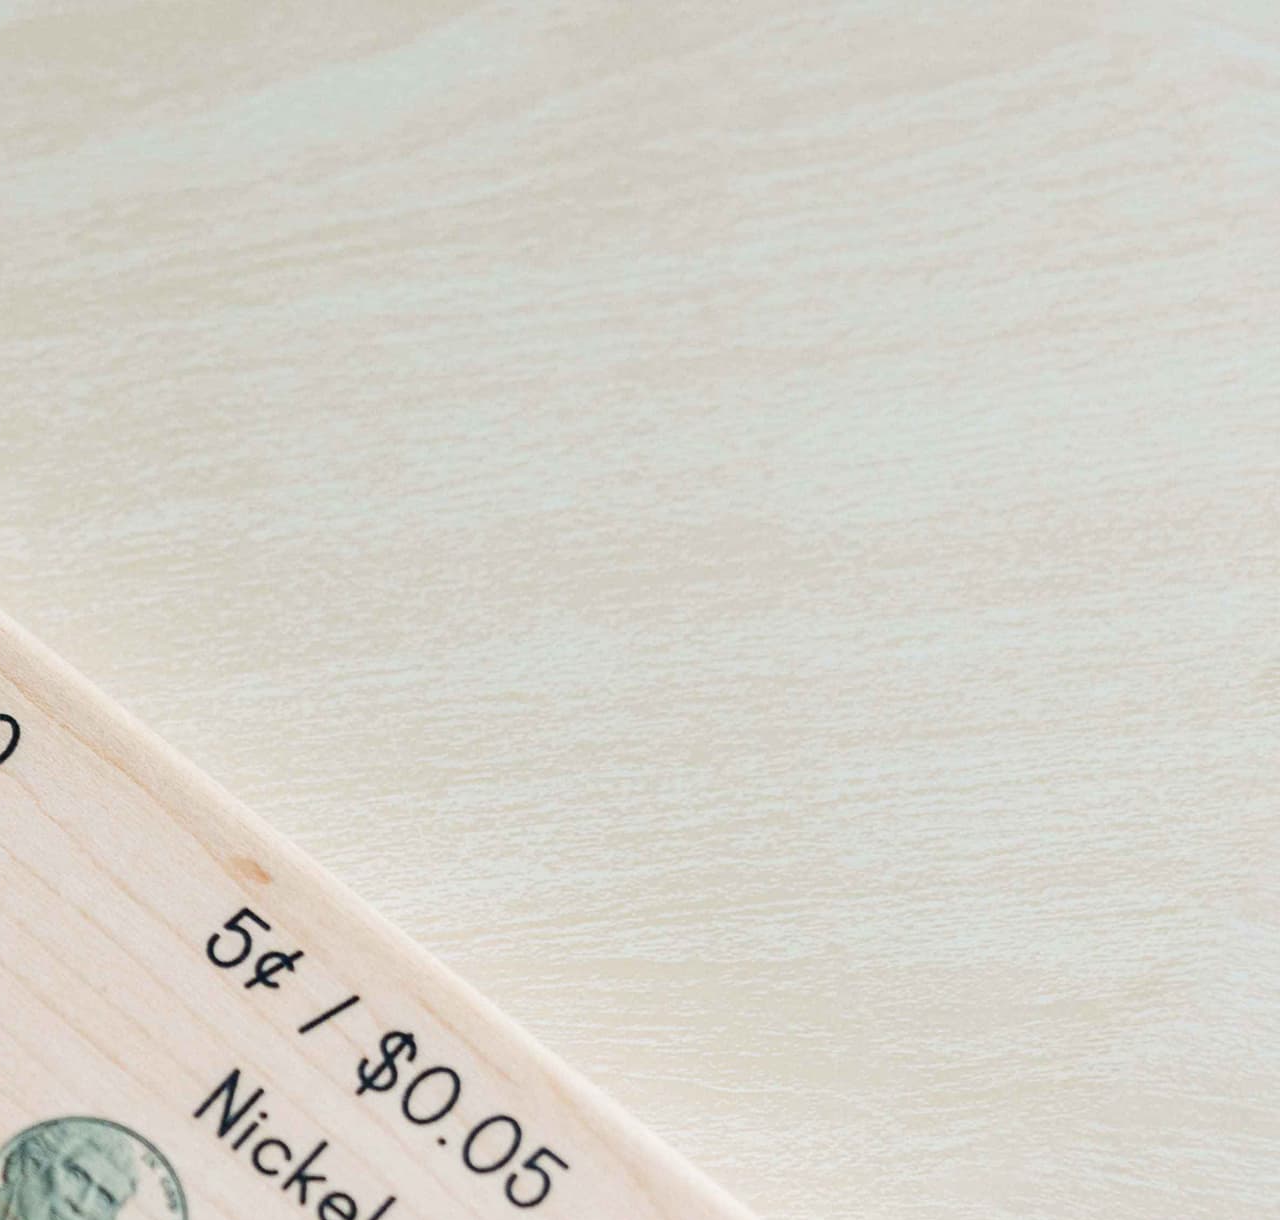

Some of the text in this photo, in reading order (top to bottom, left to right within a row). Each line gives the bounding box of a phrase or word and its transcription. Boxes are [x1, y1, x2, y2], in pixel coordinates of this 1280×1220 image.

[206, 907, 569, 1208] 5¢ / $0.05
